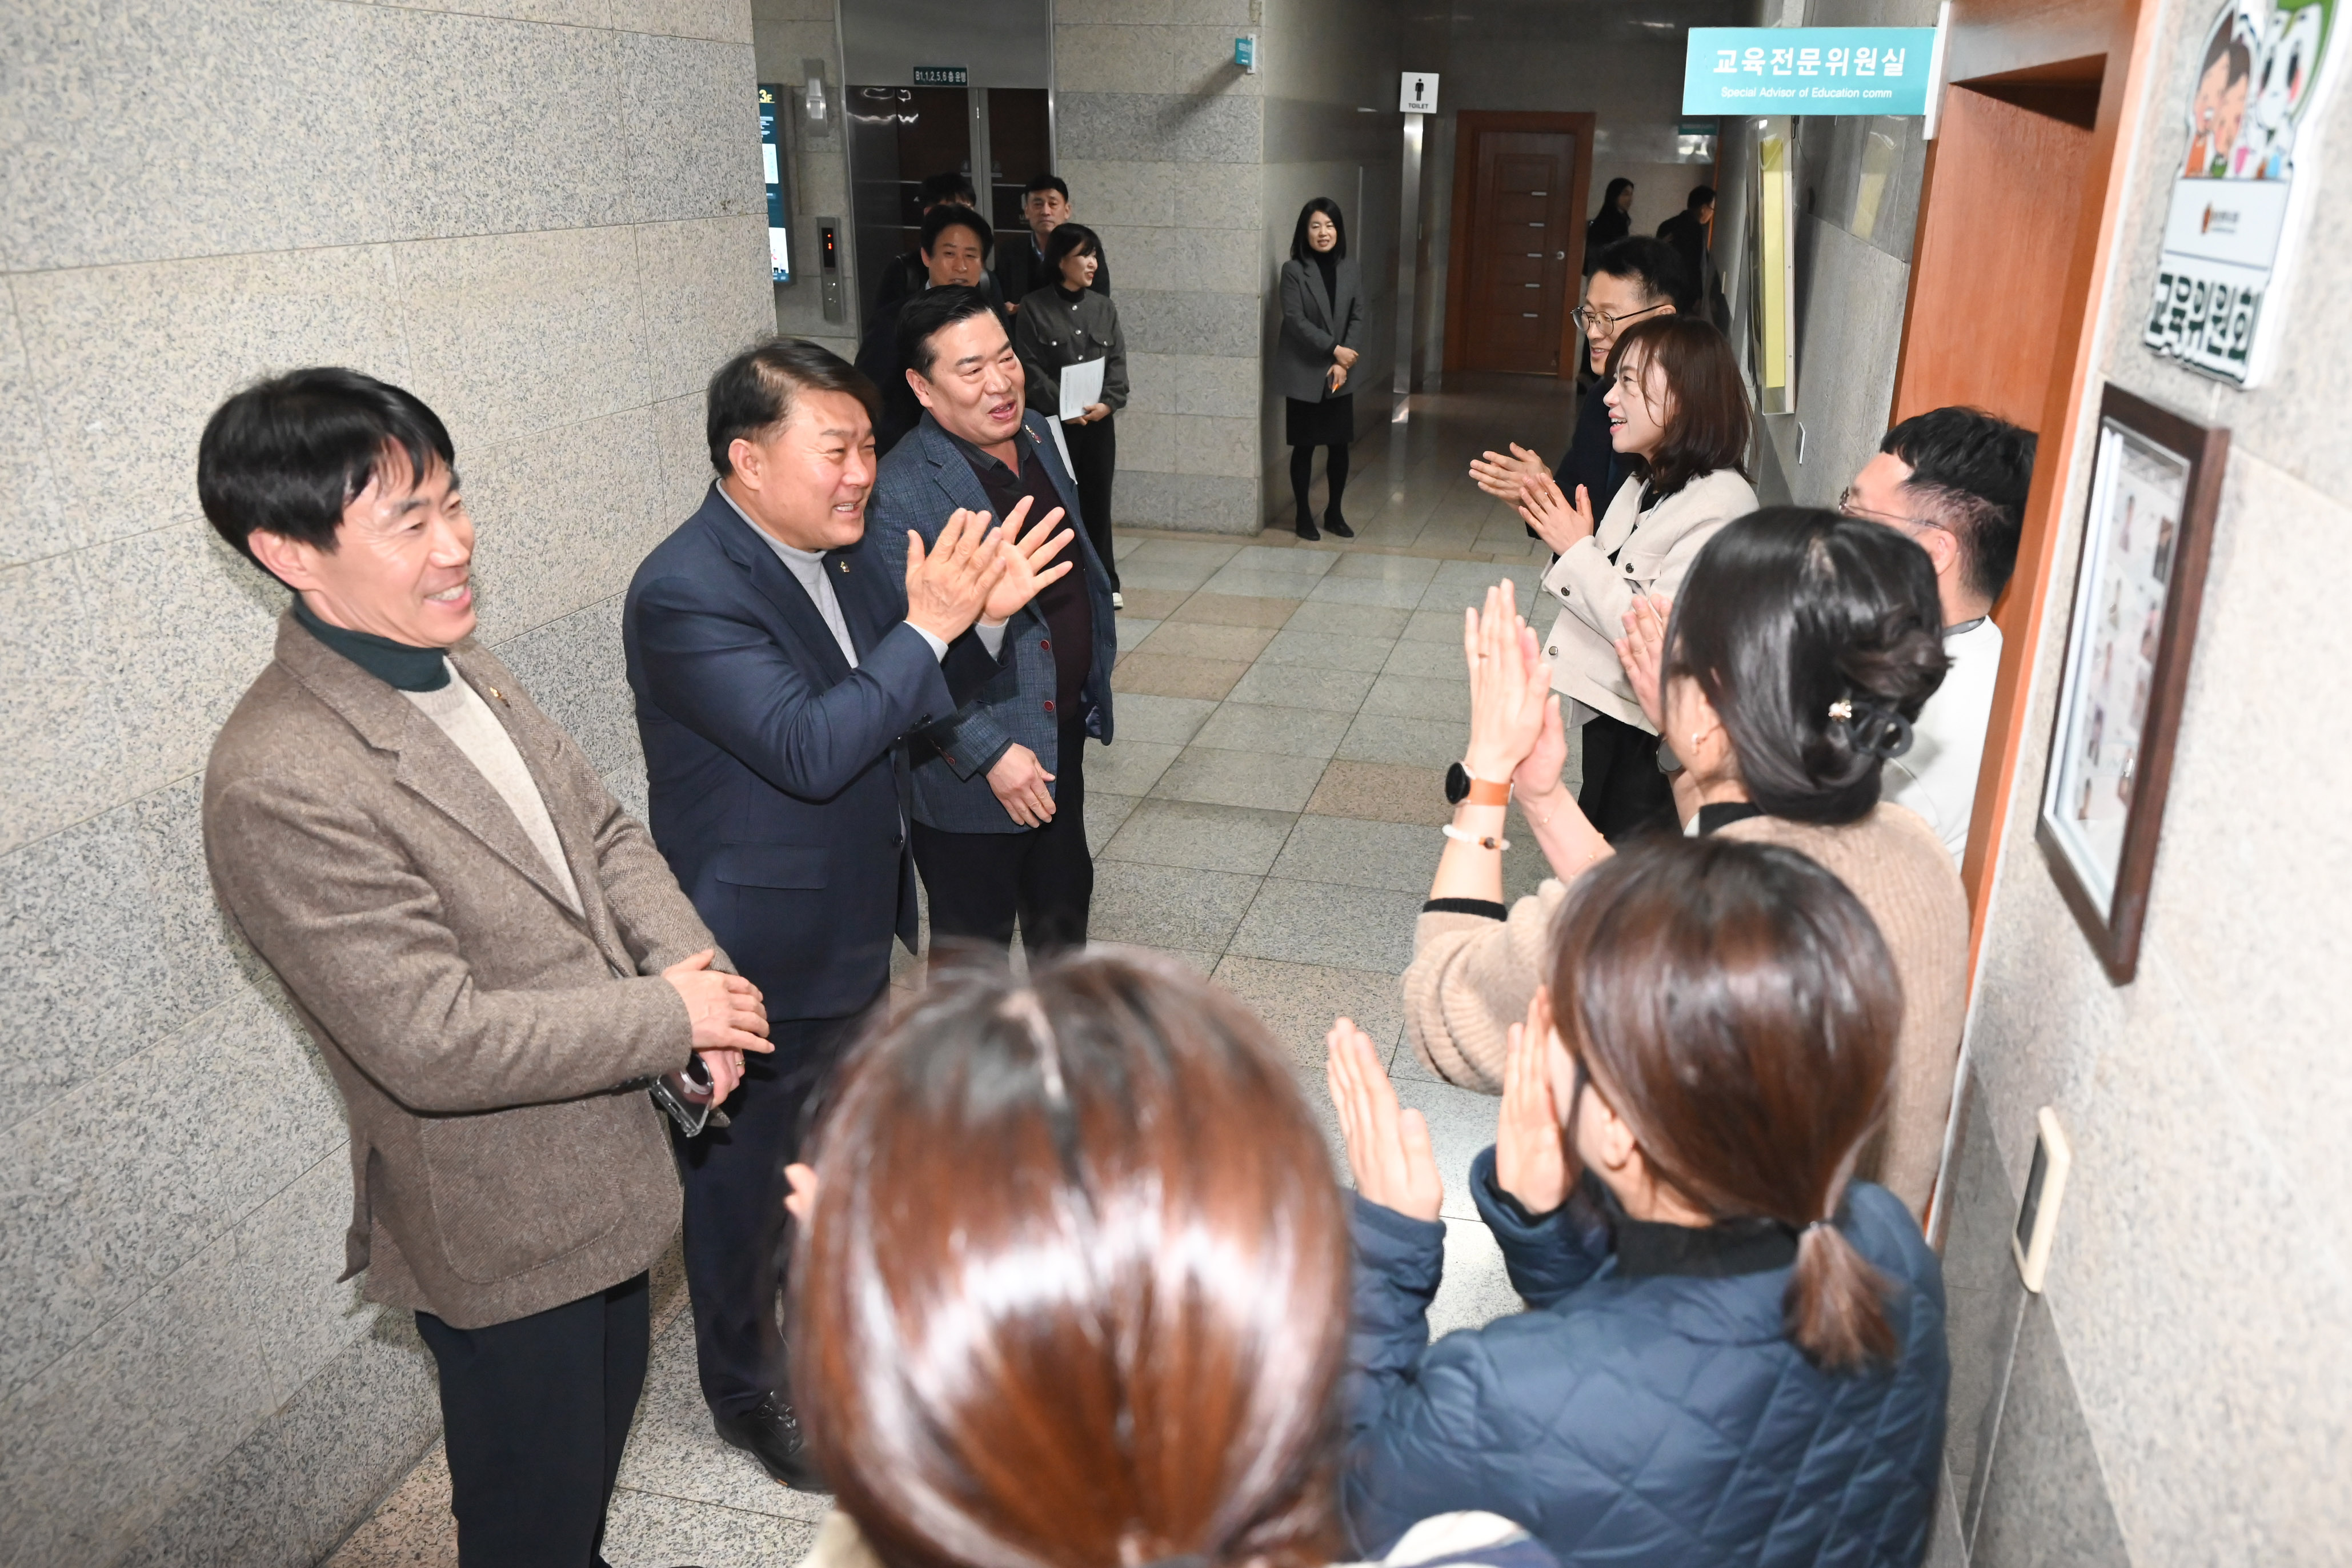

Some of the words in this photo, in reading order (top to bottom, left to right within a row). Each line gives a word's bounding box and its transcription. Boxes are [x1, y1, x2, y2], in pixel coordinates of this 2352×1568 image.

[1714, 47, 1905, 76] 교육전문위원실
[759, 89, 772, 102] 3F
[1721, 87, 1756, 98] Special
[1760, 87, 1796, 97] Advisor
[1799, 87, 1809, 97] of
[1812, 87, 1860, 98] Education
[2150, 273, 2260, 362] 교육위원회
